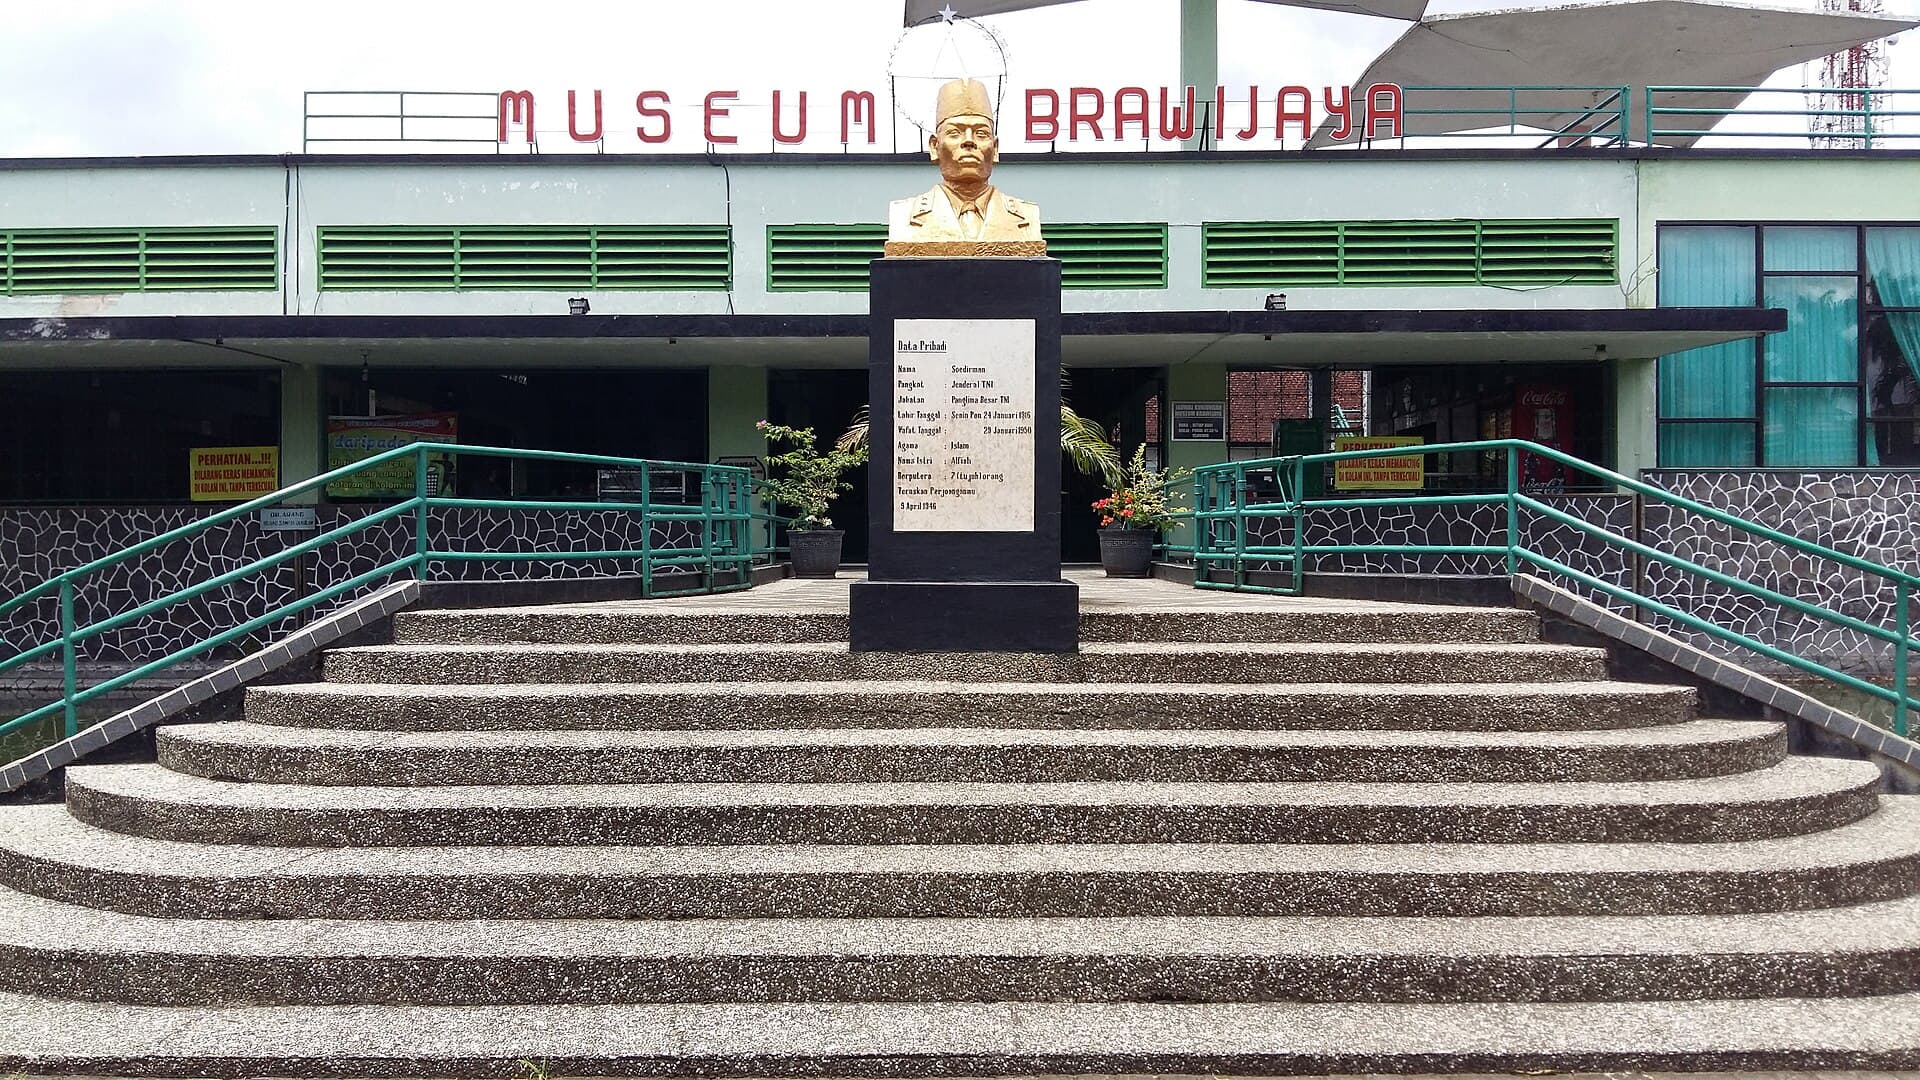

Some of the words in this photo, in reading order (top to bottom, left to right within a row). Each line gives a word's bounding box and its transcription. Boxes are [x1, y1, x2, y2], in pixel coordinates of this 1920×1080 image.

[499, 89, 876, 144] MUSEUM
[1024, 83, 1402, 142] BRAWIJAYA
[898, 340, 918, 351] Data
[920, 340, 947, 351] Pribadi
[898, 365, 916, 373] Nama
[951, 365, 986, 373] Soedirman
[898, 380, 924, 391] Pangkat
[951, 380, 980, 388] Jenderal
[981, 380, 994, 388] TNI
[898, 395, 925, 404] Jabatan
[951, 395, 979, 407] Panglima
[980, 395, 998, 404] Besar
[1000, 395, 1010, 404] TNI
[898, 410, 914, 419] Lahir
[916, 410, 941, 421] Tanggal
[951, 410, 969, 419] Senin
[983, 410, 992, 419] 24
[993, 410, 1018, 419] Januari
[898, 426, 916, 434] Wafat
[918, 426, 942, 436] Tanggal
[993, 426, 1018, 434] Januari
[1018, 426, 1032, 434] 1950
[898, 441, 918, 452] Agama
[950, 441, 970, 450] Islam
[898, 456, 915, 465] Nama
[916, 456, 933, 465] Istri
[1339, 459, 1367, 468] DILARANG
[1368, 459, 1385, 468] KERAS
[1386, 458, 1420, 468] MEMANCING
[194, 470, 223, 480] DILARANG
[223, 469, 241, 479] KERAS
[242, 468, 275, 478] MEMANCING
[898, 472, 932, 482] Berputera
[982, 472, 1004, 482] orang
[1339, 471, 1345, 481] DI
[1345, 471, 1363, 481] KOLAM
[1374, 471, 1390, 481] TANPA
[195, 483, 201, 493] DI
[201, 483, 219, 493] KOLAM
[230, 482, 246, 492] TANPA
[898, 487, 928, 495] Teruskan
[906, 502, 921, 511] April
